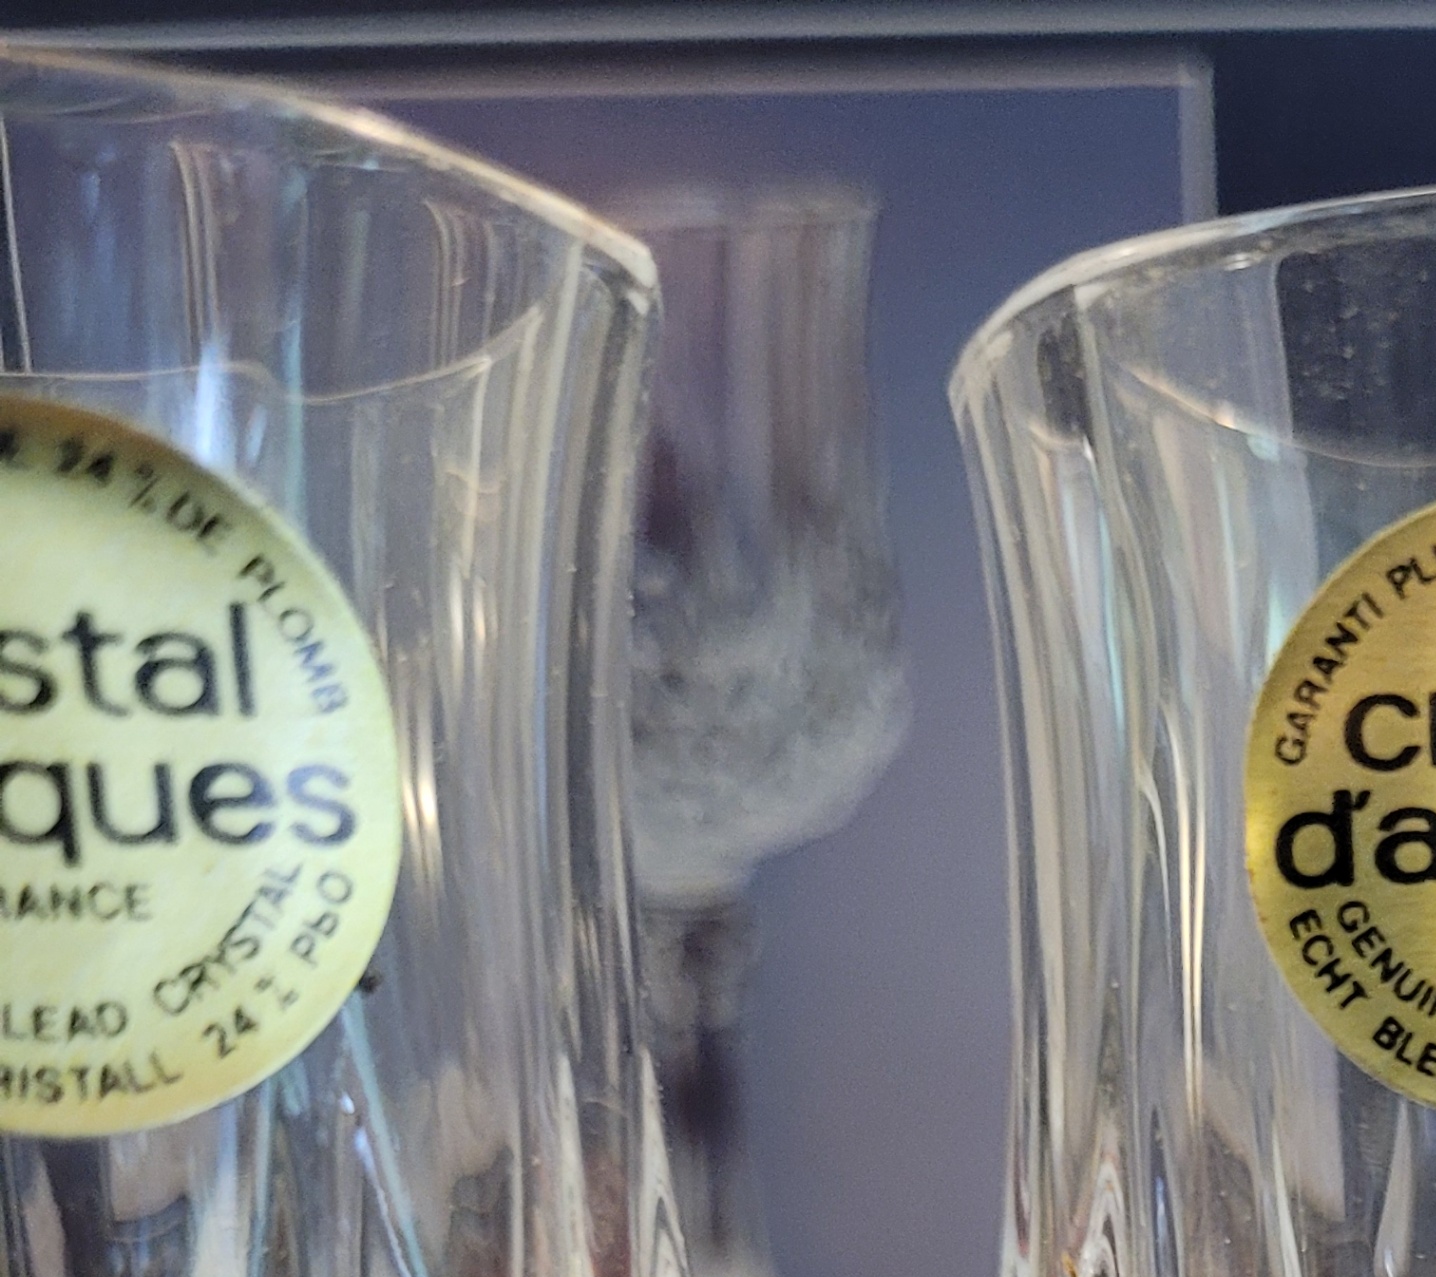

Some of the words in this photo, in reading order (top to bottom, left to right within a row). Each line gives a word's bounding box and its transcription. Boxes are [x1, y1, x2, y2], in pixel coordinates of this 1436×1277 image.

[164, 488, 236, 558] DE
[238, 554, 348, 716] PLOMB
[1275, 592, 1385, 767] GARANTI
[2, 1001, 128, 1042] LEAD
[154, 864, 303, 1018] CRYSTAL
[1289, 908, 1370, 1012] ECHT
